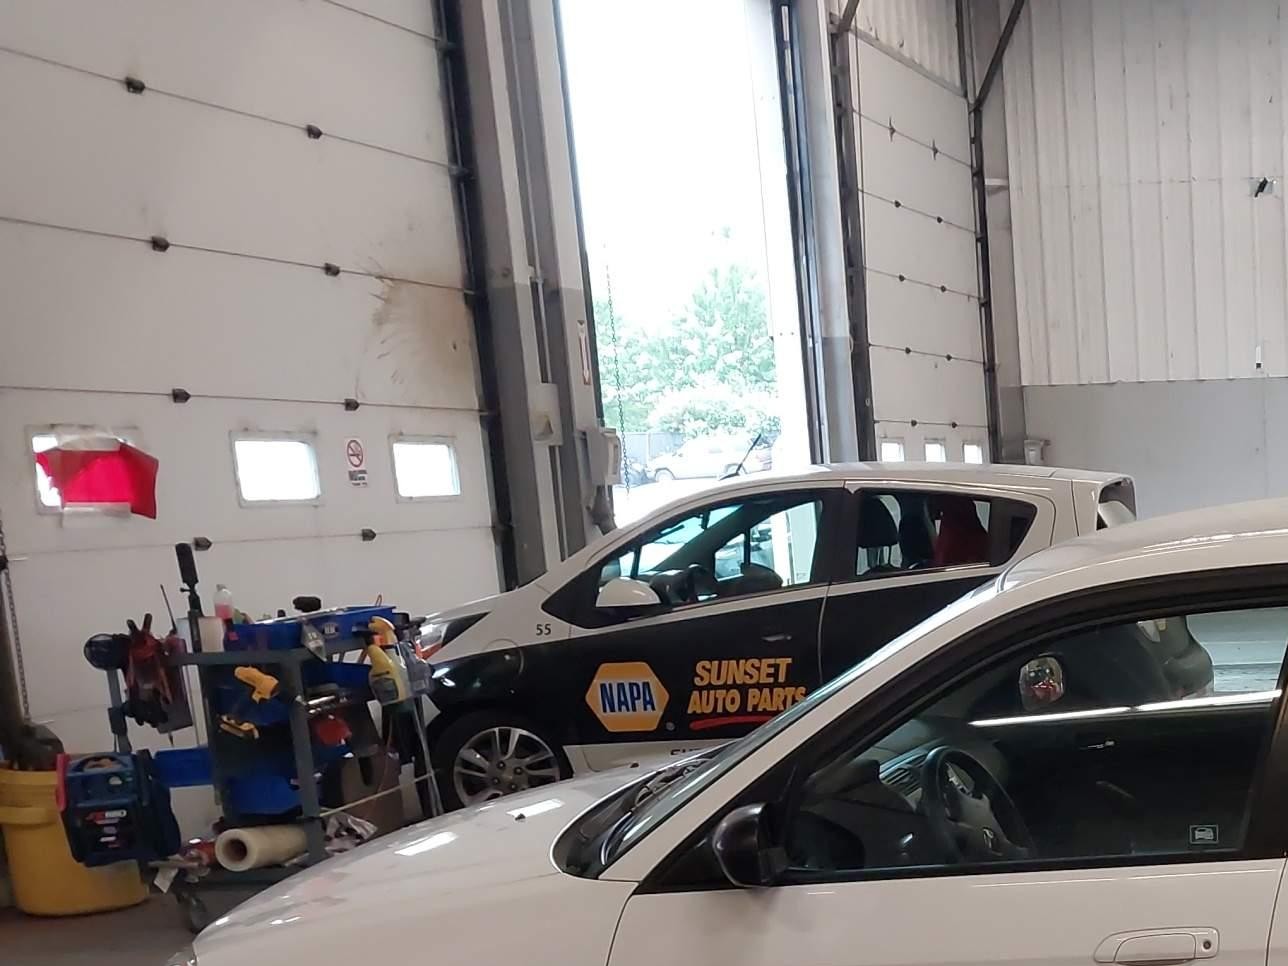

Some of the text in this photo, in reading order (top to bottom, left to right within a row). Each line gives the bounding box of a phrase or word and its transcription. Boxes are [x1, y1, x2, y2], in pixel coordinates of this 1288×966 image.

[536, 623, 552, 636] 55
[694, 658, 792, 687] SUNSET
[599, 681, 657, 714] NAPA
[687, 686, 807, 715] AUTO PARTS
